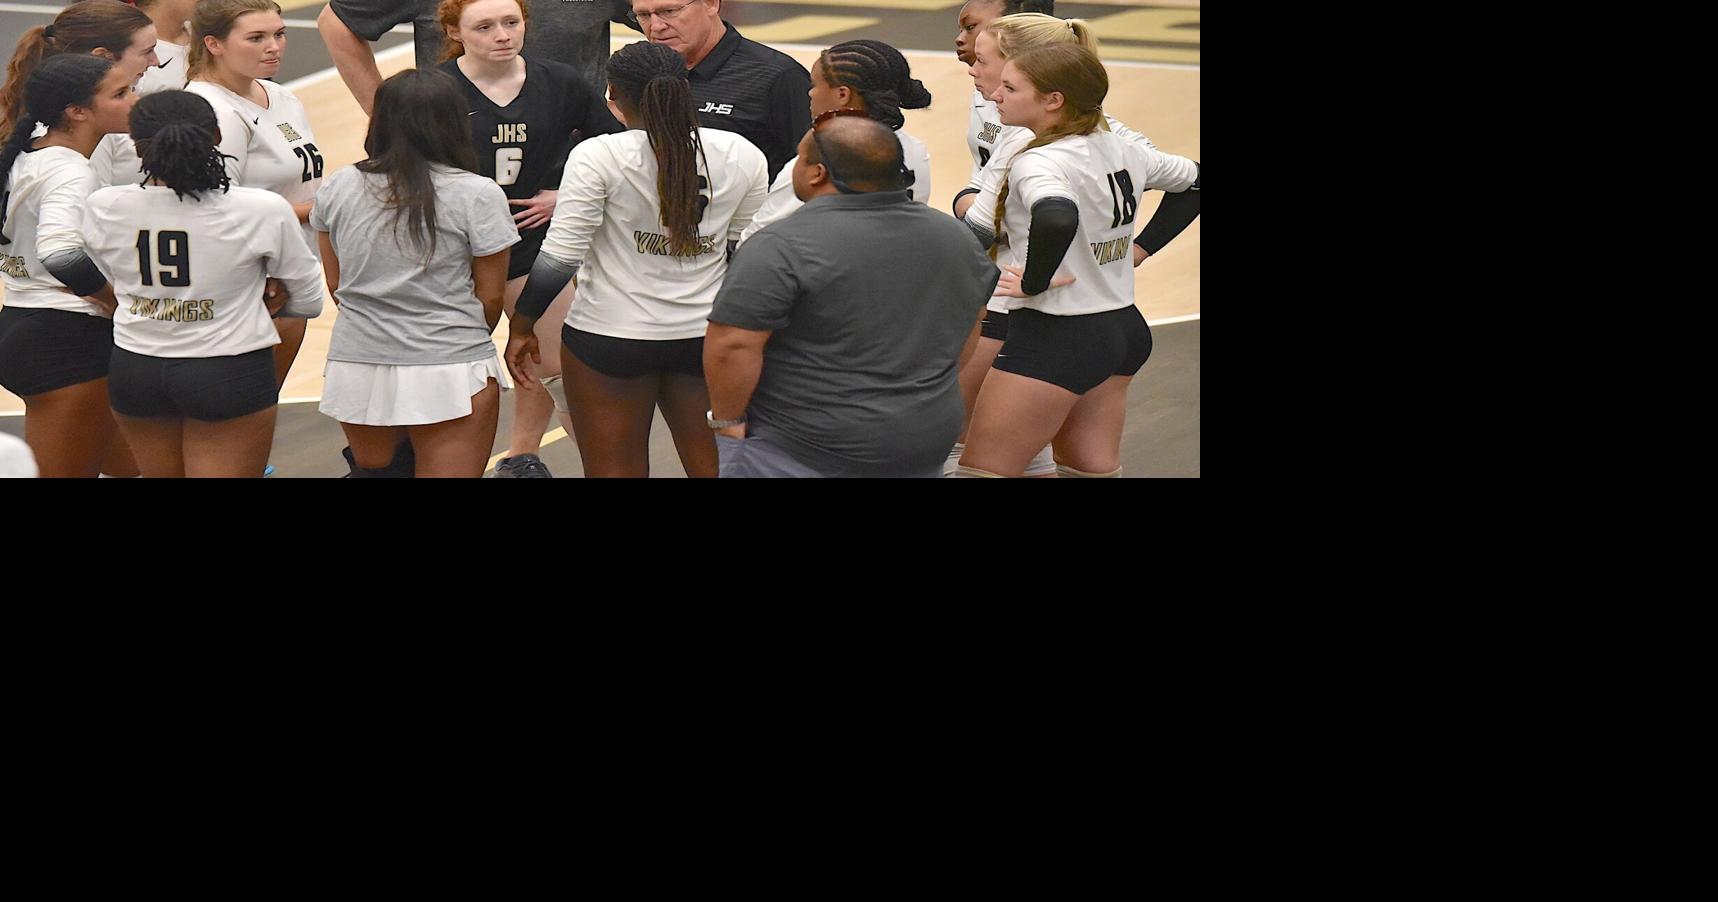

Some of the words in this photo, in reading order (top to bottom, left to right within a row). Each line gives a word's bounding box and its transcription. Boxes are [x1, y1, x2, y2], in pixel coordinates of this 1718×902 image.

[698, 101, 734, 115] JHS
[491, 123, 527, 144] JHS
[293, 142, 324, 183] 26
[495, 147, 523, 186] 6
[1107, 168, 1137, 229] 18
[135, 229, 190, 287] 19
[633, 230, 717, 257] VIKGS
